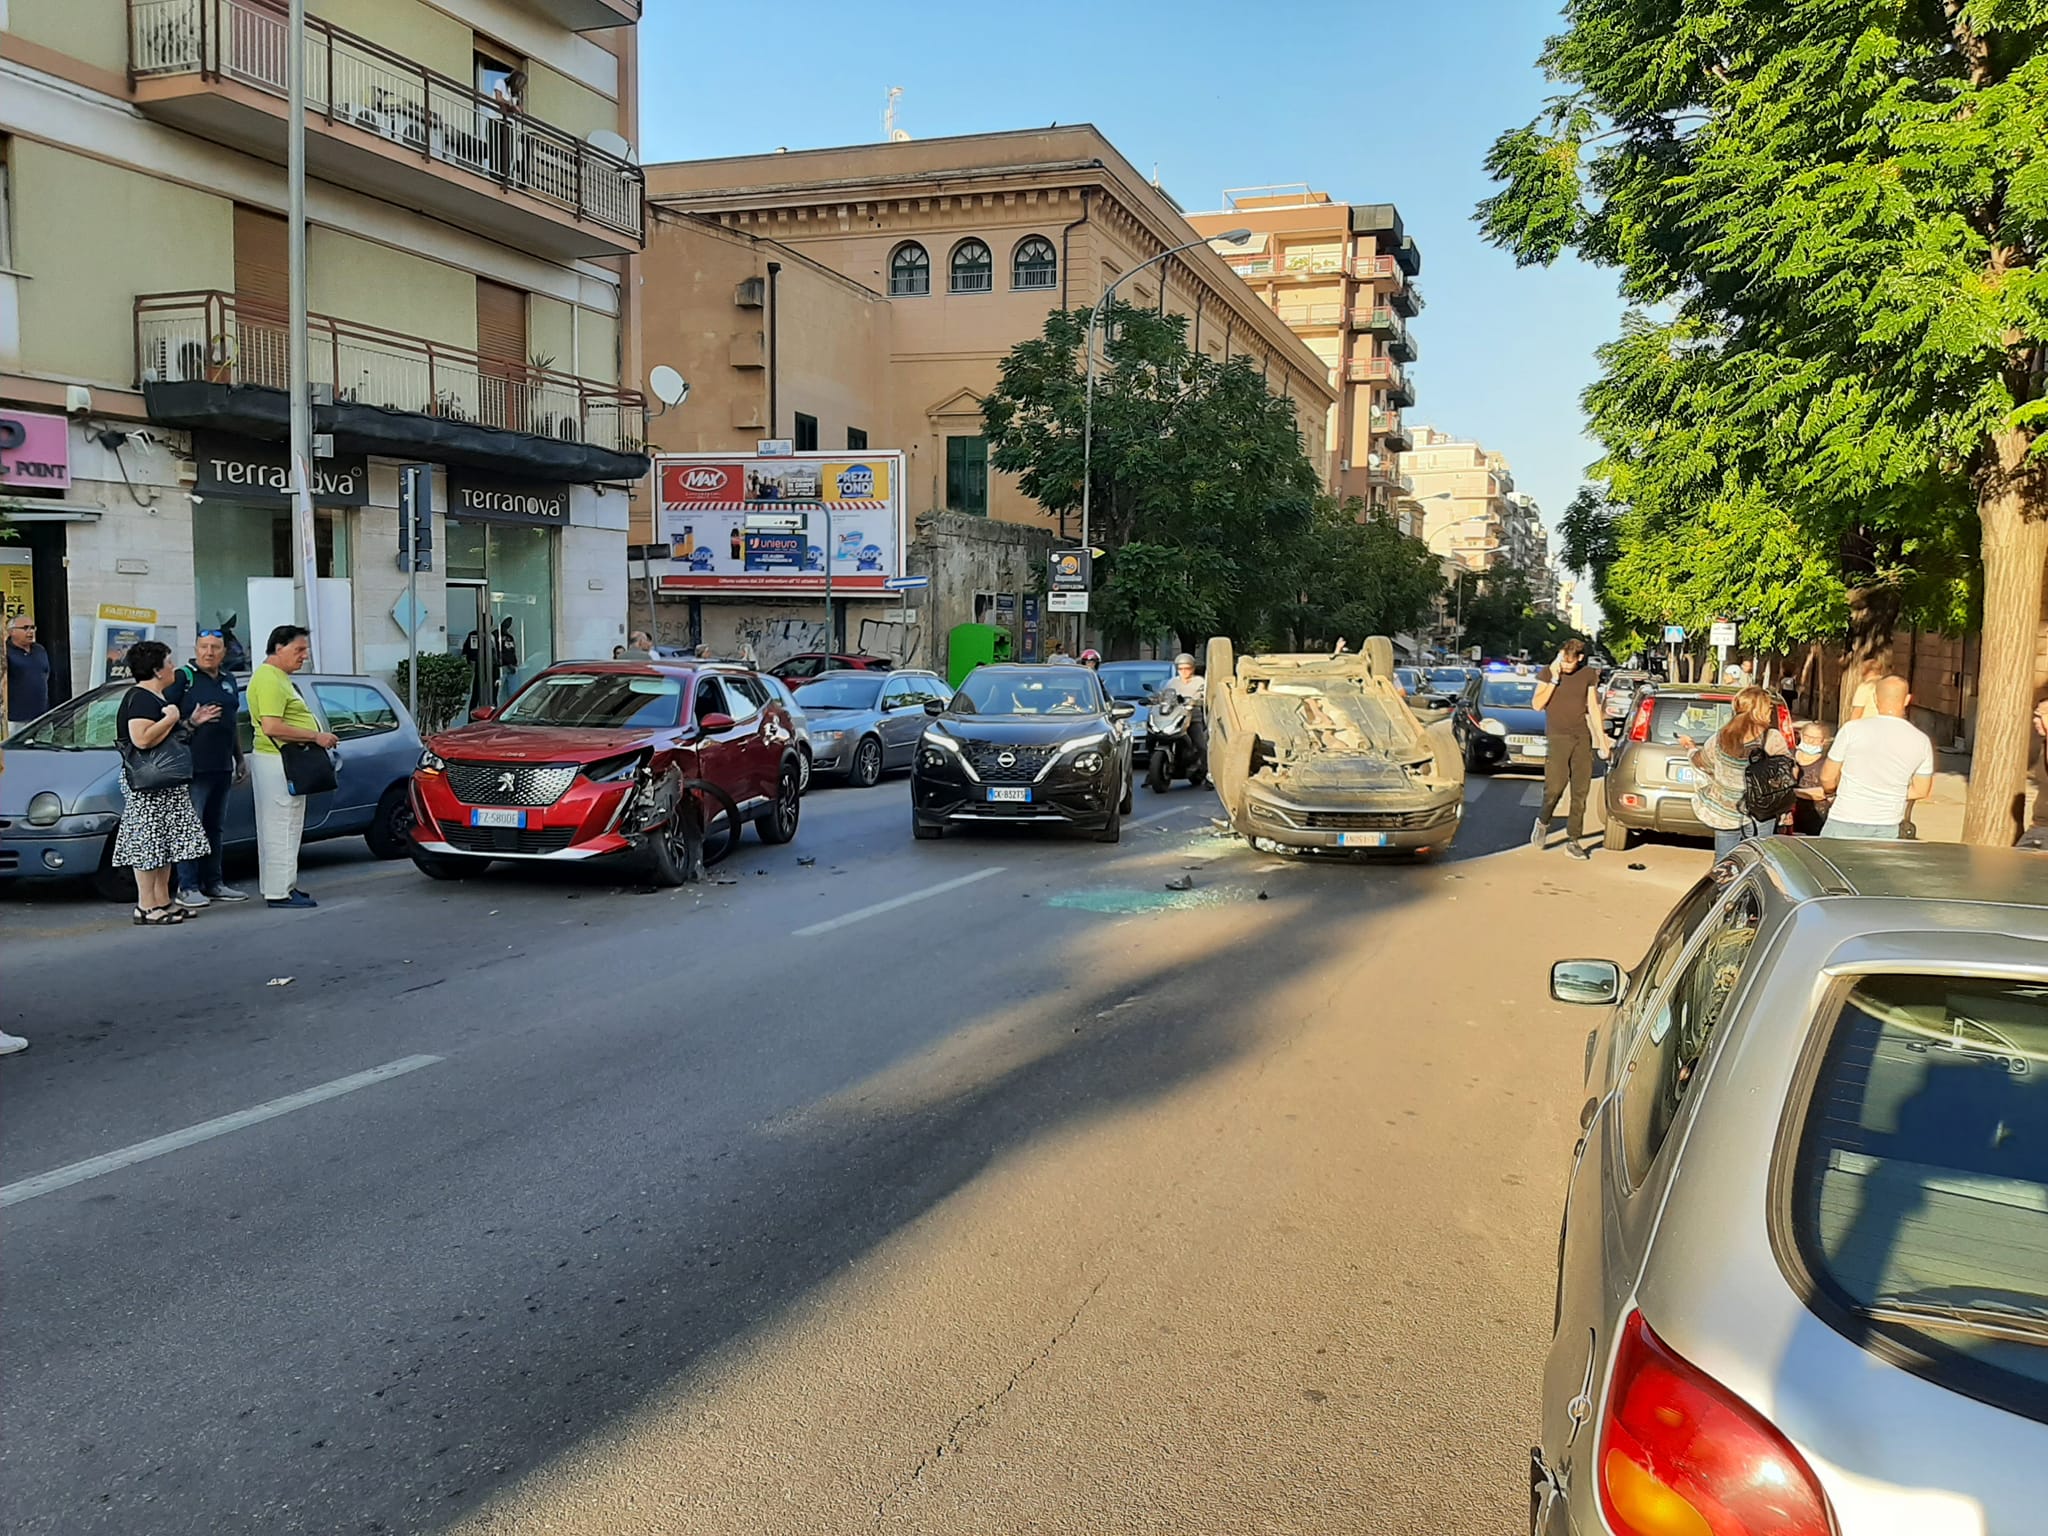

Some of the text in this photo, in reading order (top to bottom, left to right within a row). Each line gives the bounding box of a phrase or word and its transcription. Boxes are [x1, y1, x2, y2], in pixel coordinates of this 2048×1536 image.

[15, 460, 66, 479] POINT
[210, 459, 354, 495] Terrava
[686, 471, 722, 487] MAX
[837, 471, 874, 482] PREZZI
[837, 482, 874, 493] TONDI
[760, 538, 798, 549] unieuro
